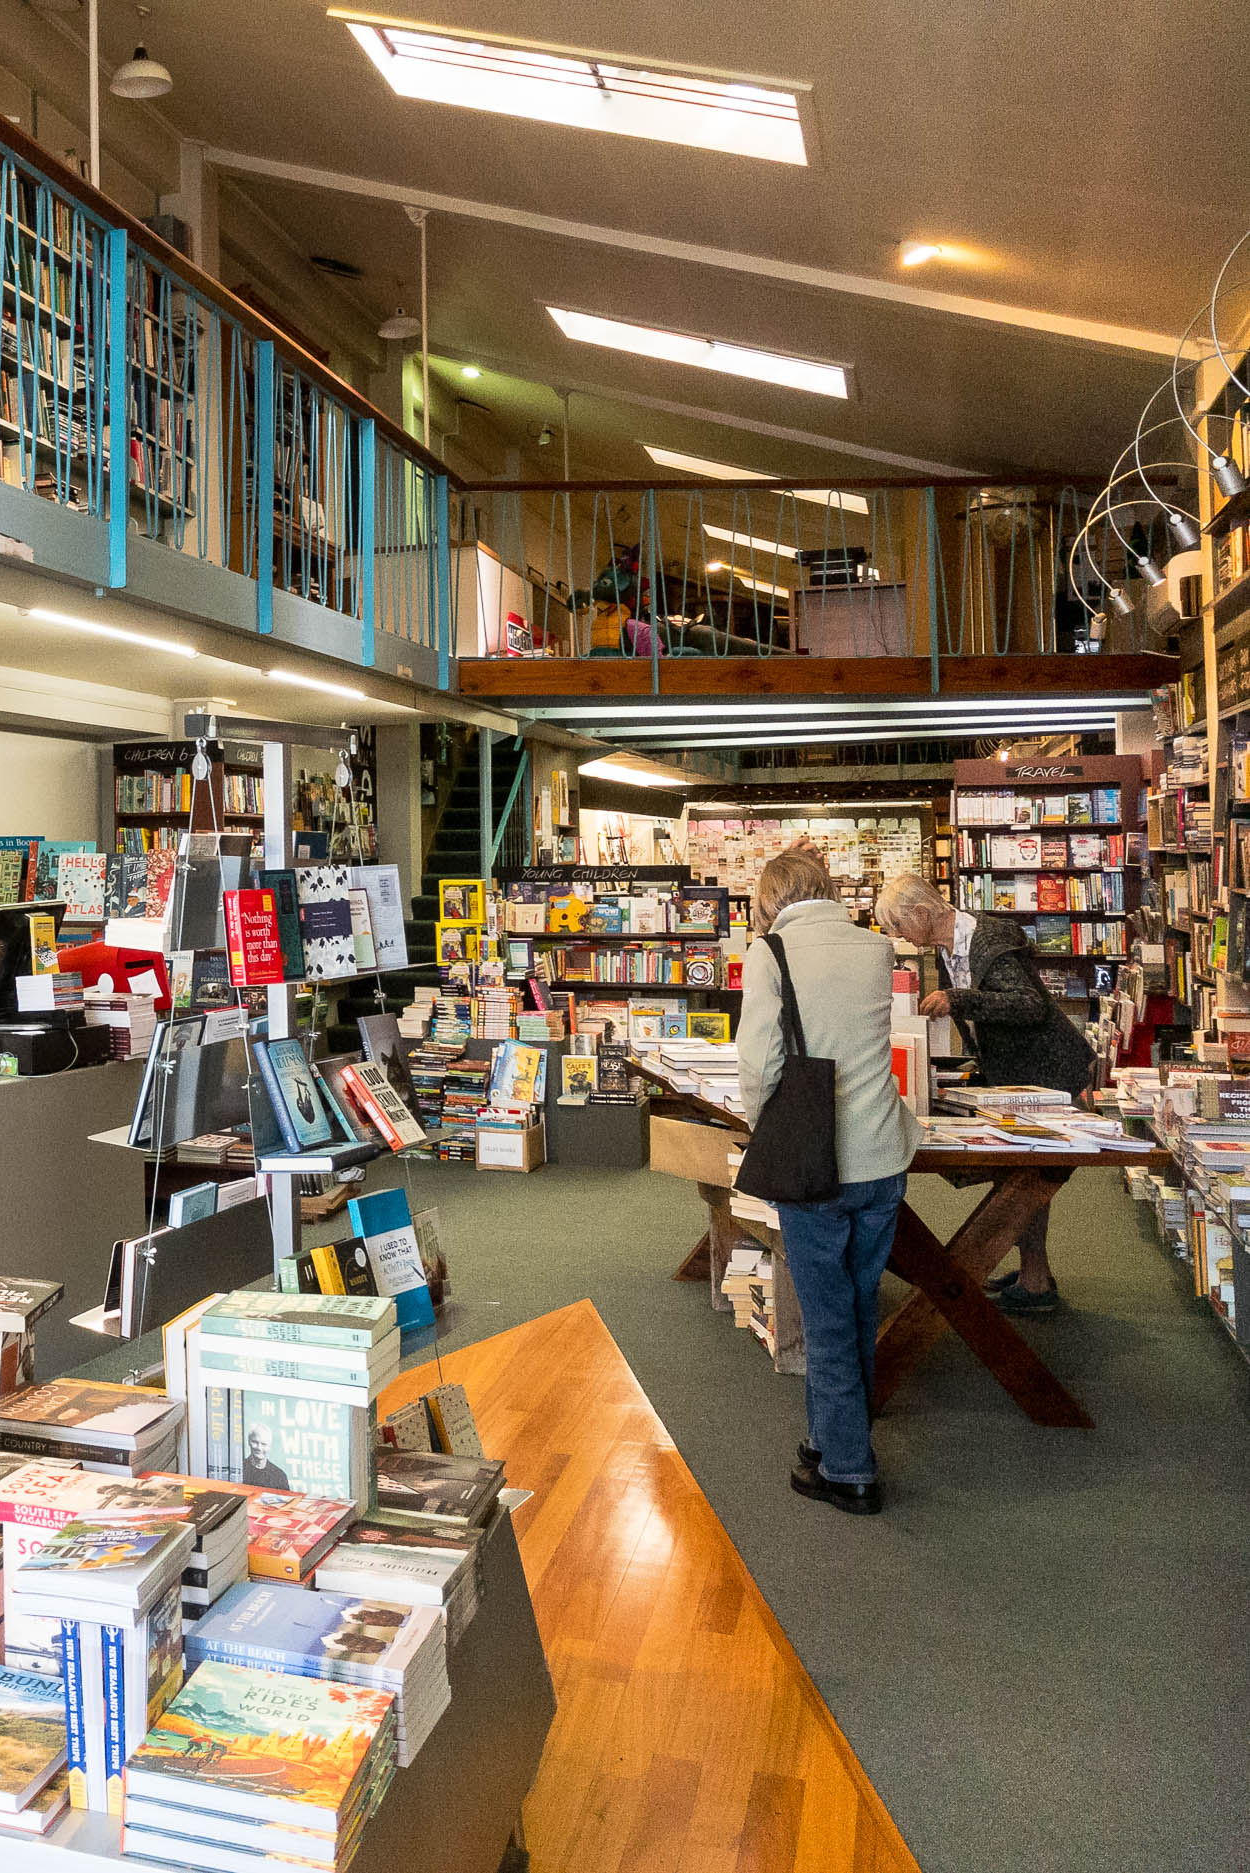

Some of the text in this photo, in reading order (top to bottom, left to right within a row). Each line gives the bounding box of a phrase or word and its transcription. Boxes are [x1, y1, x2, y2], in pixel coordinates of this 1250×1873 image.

[1014, 765, 1076, 778] TRAVEL
[62, 856, 106, 869] HELLO
[125, 863, 148, 874] TIME
[521, 868, 639, 880] YOUNG CHILDREN
[64, 904, 104, 916] ATLAS
[241, 913, 273, 928] "Nothing
[245, 926, 271, 938] is worth
[246, 939, 278, 950] more than
[247, 951, 260, 963] this
[379, 1246, 413, 1261] KNOW THAT
[0, 1385, 60, 1416] COUNTRY
[261, 1398, 342, 1428] IN LOVE
[4, 1438, 48, 1451] COUNTRY
[280, 1430, 340, 1461] WITH
[285, 1458, 341, 1481] THESE
[1, 1467, 46, 1496] SOUTH
[24, 1474, 71, 1497] SEA
[13, 1503, 75, 1522] SOUTH SEA
[205, 1640, 287, 1663] AT THE BEACH
[205, 1653, 285, 1675] AT THE BEACH
[23, 1684, 66, 1699] NIGHT
[65, 1638, 81, 1763] NEW ZEALAND'S BEST TRIPS
[108, 1645, 121, 1770] NEW ZEALAND'S BEST TRIPS
[243, 1691, 319, 1712] RIDES
[239, 1703, 311, 1722] WORLD
